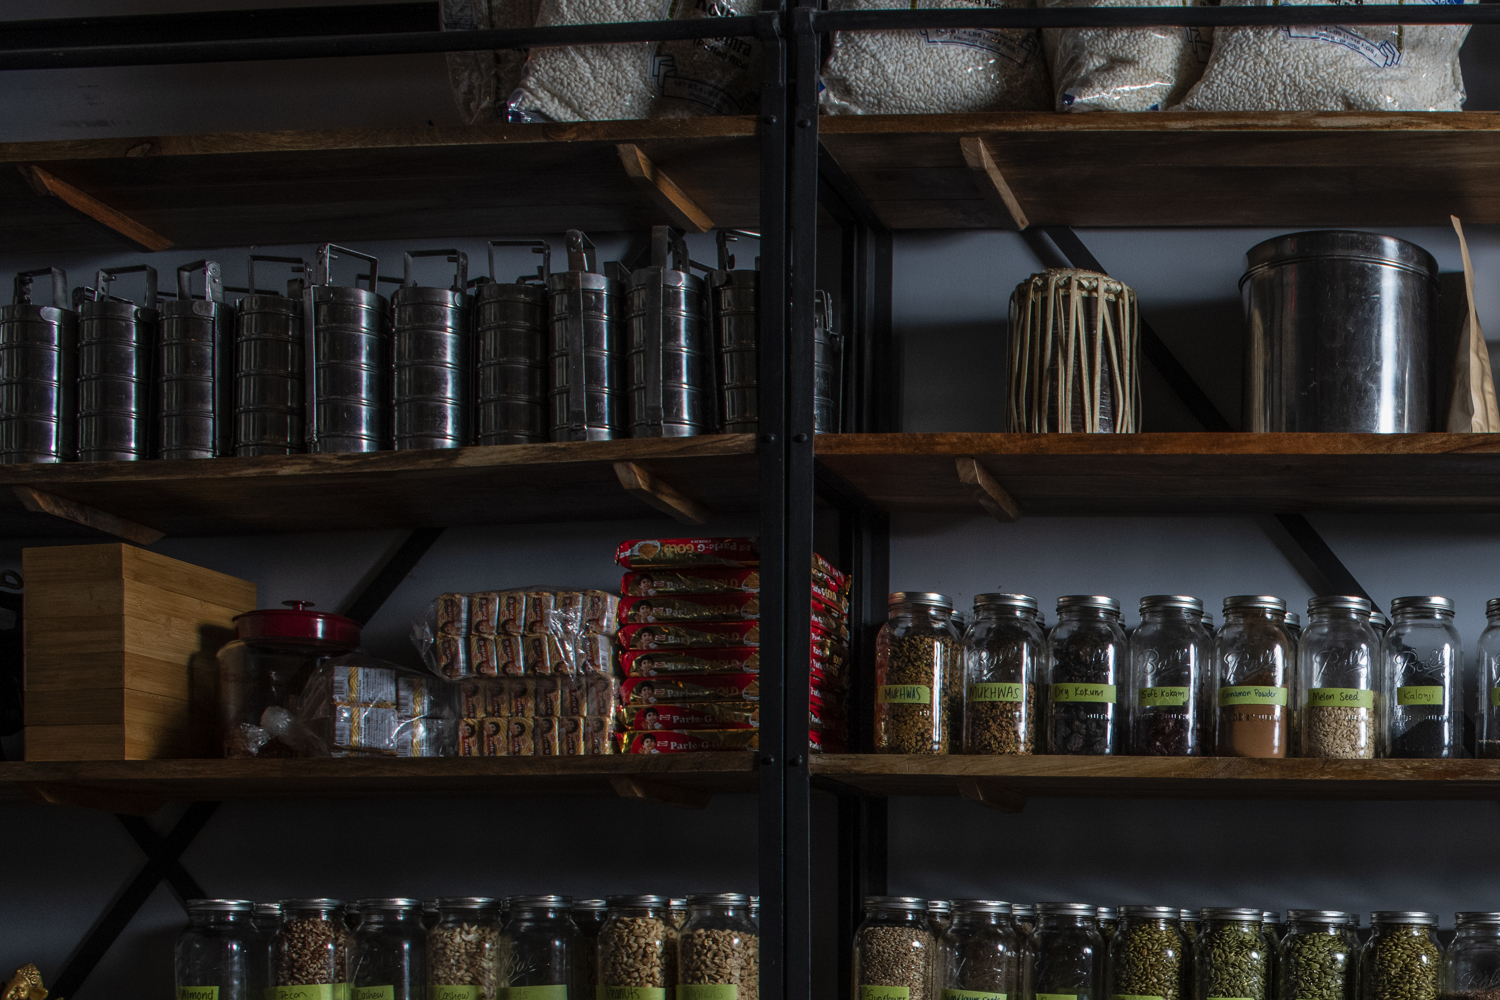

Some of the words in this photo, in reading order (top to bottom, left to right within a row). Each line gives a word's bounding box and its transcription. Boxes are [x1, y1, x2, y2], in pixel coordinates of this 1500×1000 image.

[728, 55, 750, 72] Rice)
[885, 687, 921, 700] MUKHWAS
[970, 687, 1020, 699] MUKHWAS
[1055, 686, 1068, 697] Dry
[1075, 686, 1103, 696] Kokum
[1142, 690, 1157, 699] Soft
[1254, 689, 1276, 698] Powder
[1313, 691, 1334, 700] Melon
[1340, 691, 1360, 701] Seed
[1404, 690, 1434, 701] Kalonji
[672, 714, 712, 724] Parle-G
[669, 740, 710, 751] Parle-G
[181, 990, 213, 1000] Almond
[357, 990, 384, 1000] Cashew
[438, 988, 469, 1000] Cashew
[605, 985, 640, 999] Peanuts
